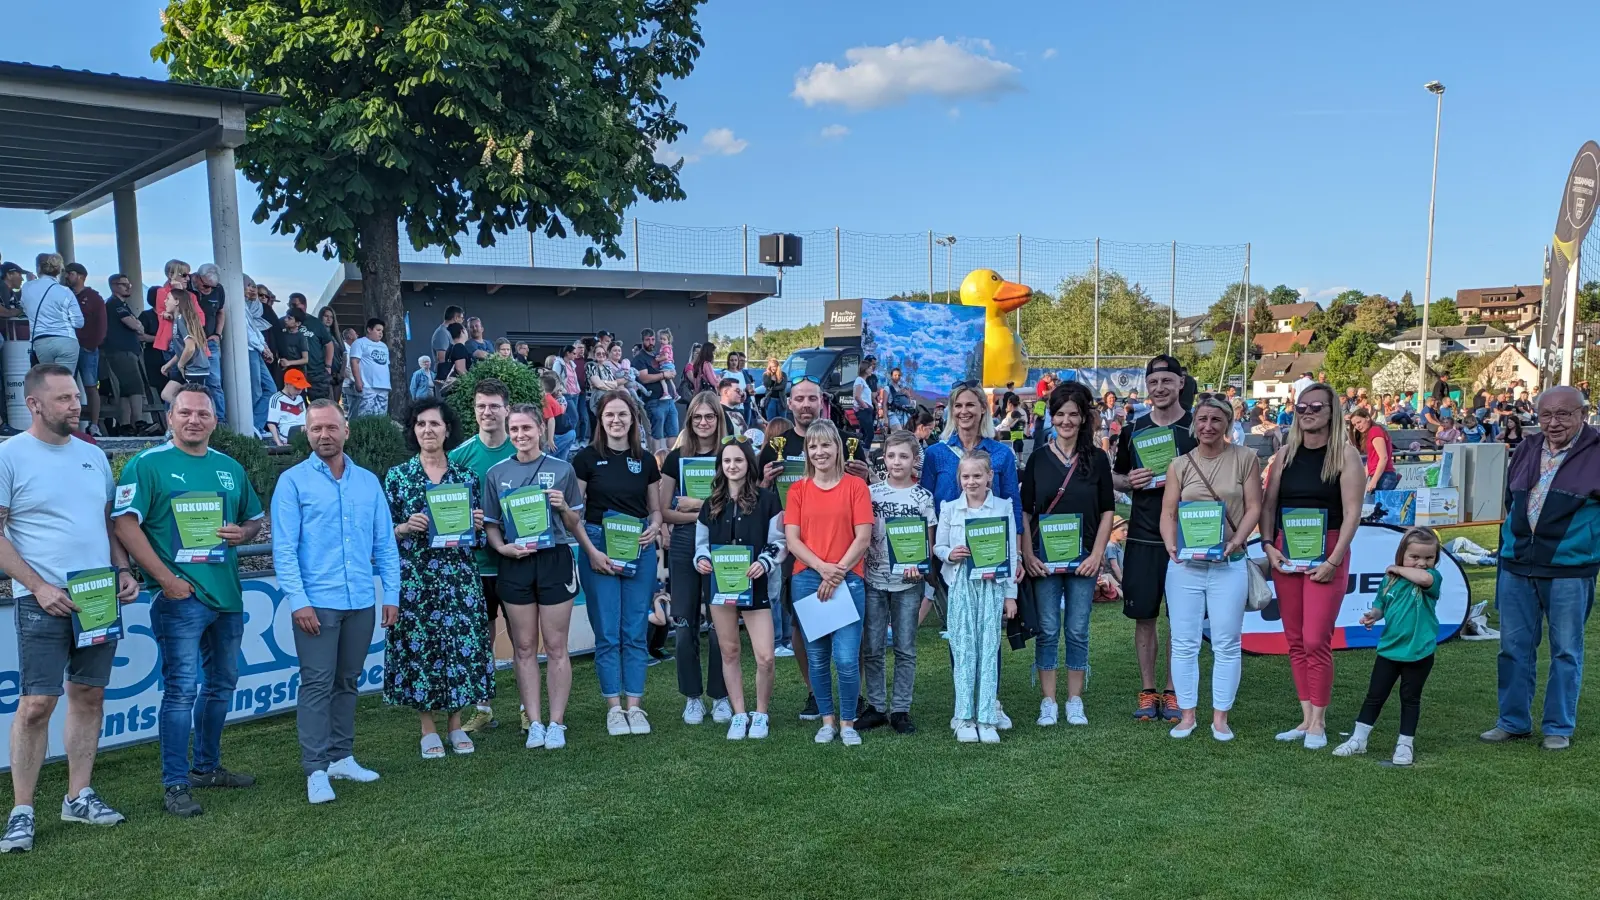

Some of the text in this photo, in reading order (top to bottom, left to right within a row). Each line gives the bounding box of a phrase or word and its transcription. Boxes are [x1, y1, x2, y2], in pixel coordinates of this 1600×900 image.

[830, 311, 856, 323] Hauser
[1136, 433, 1173, 449] URKUNDE
[686, 469, 716, 477] URKUND
[430, 492, 468, 503] URKUNDE
[510, 493, 544, 507] URKUNDE
[175, 502, 221, 512] URKUNDE
[1181, 510, 1221, 519] URKUNDE
[606, 522, 641, 534] URKUNDE
[1042, 522, 1078, 533] URKUNDE
[1286, 518, 1321, 527] URKUNDE
[888, 525, 924, 535] URKUNDE
[968, 525, 1004, 537] URKUNDE
[715, 555, 749, 563] URKUNDE
[71, 577, 114, 594] URKUNDE
